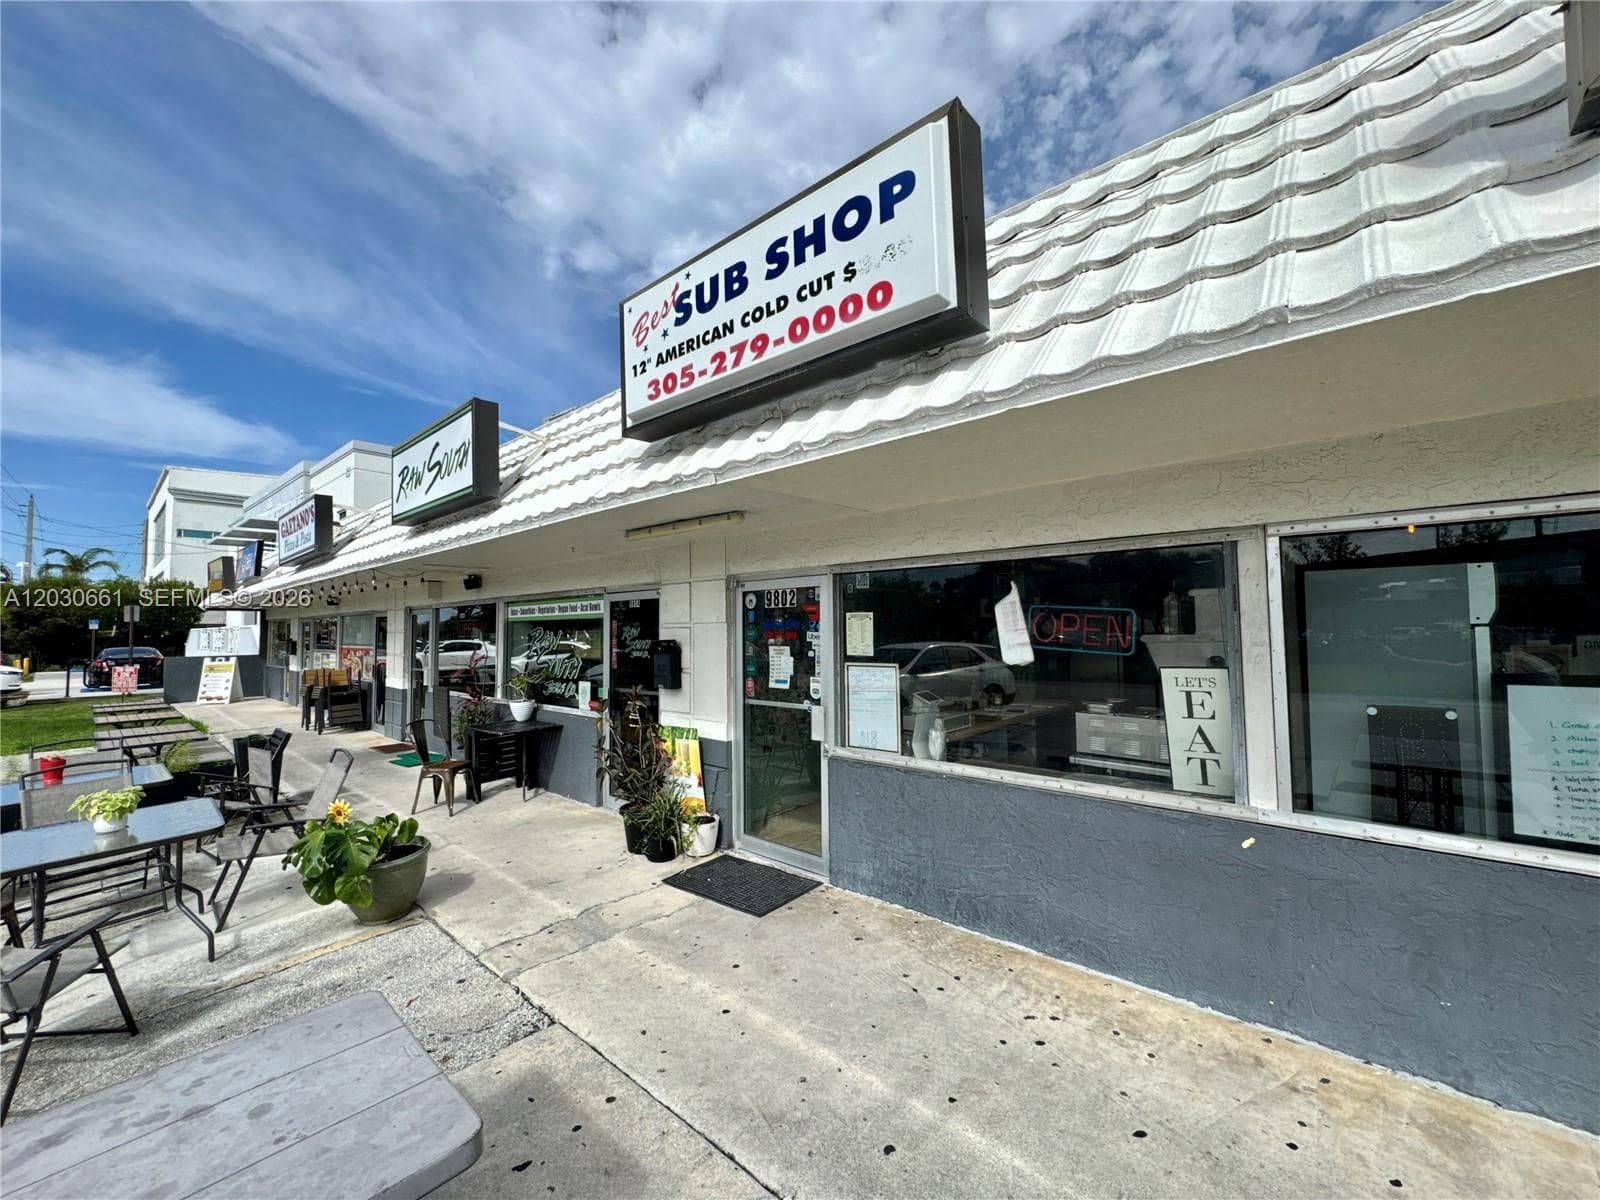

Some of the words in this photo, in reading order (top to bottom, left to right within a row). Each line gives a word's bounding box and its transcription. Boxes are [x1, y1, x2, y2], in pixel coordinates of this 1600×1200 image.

[632, 282, 680, 347] Best
[674, 261, 749, 327] SUB
[764, 169, 917, 281] SHOP
[632, 357, 652, 378] 12"
[655, 319, 735, 368] AMERICAN
[740, 294, 789, 329] COLD
[796, 271, 836, 303] CUT
[647, 280, 894, 401] 305-279-0000
[281, 504, 315, 539] GAETANO'S
[765, 589, 796, 607] 9802
[1032, 612, 1132, 648] OPEN
[1174, 676, 1217, 688] LET'S
[1178, 689, 1222, 788] EAT
